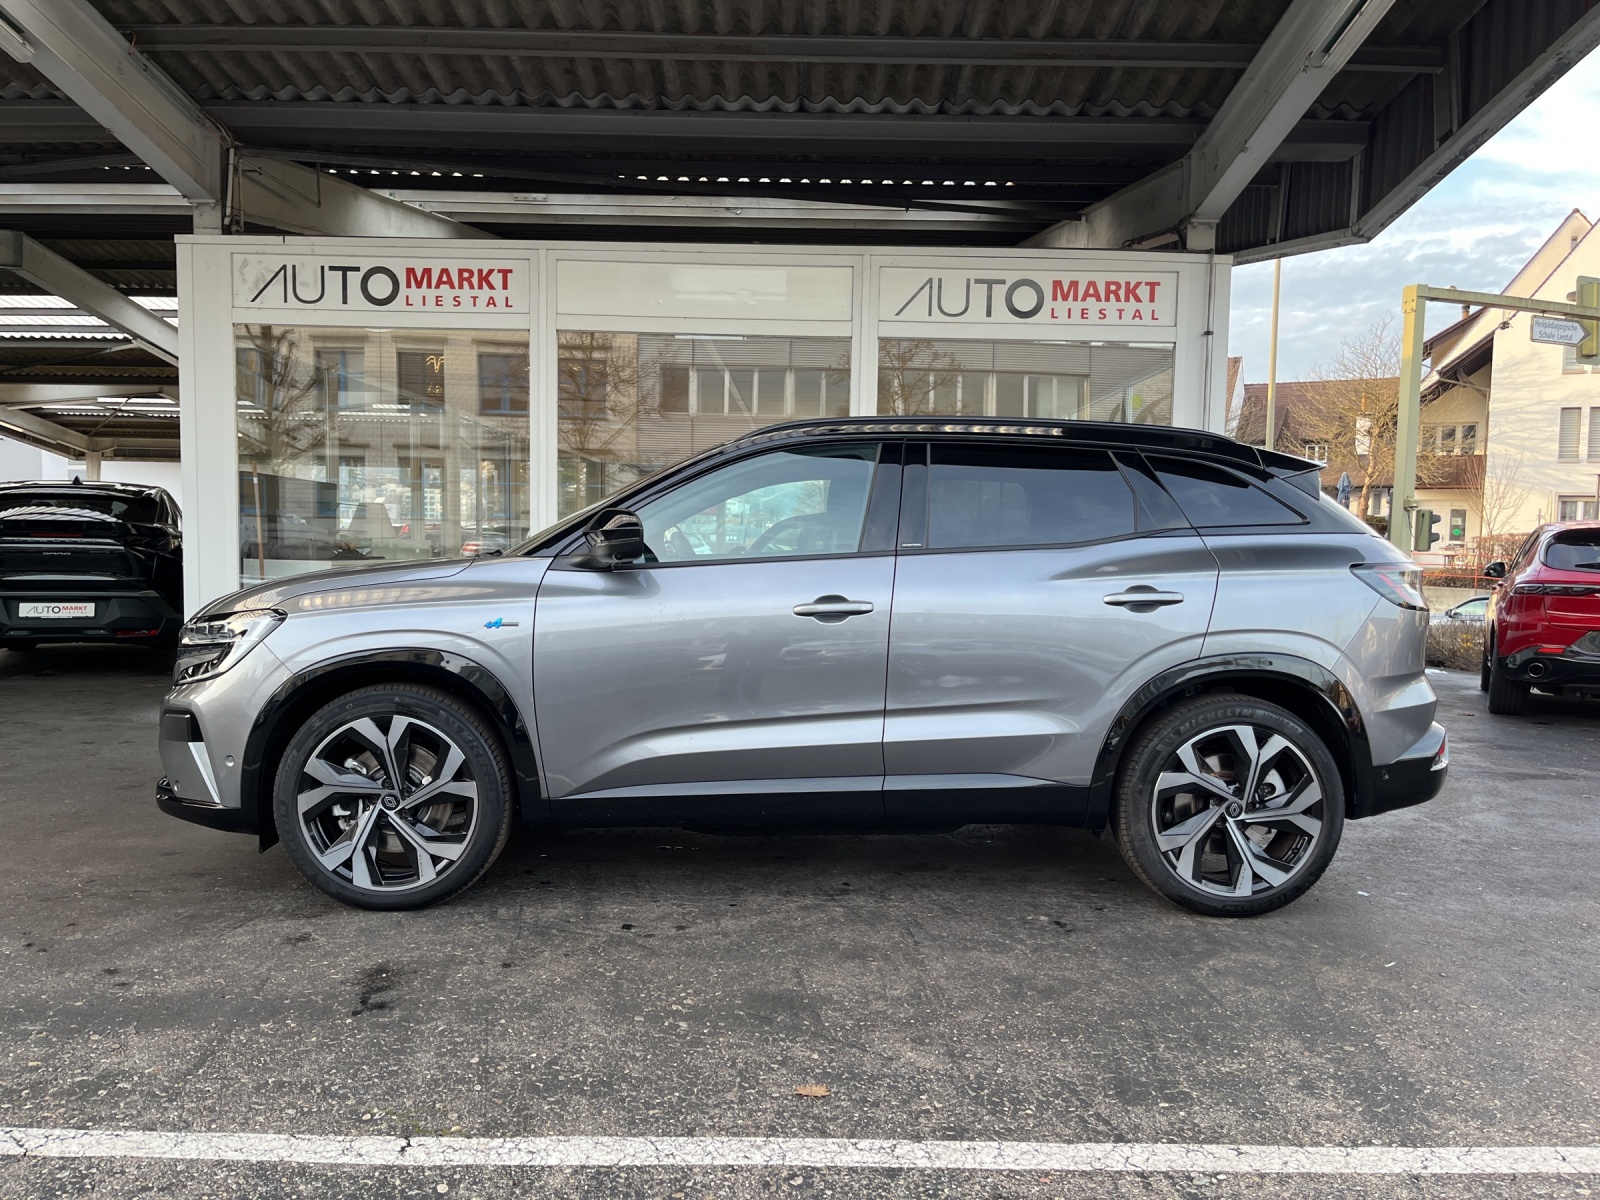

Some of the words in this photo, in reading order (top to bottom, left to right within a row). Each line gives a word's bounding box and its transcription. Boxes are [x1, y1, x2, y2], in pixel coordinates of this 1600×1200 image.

[250, 264, 400, 307] AUTO
[405, 267, 514, 291] MARKT
[405, 295, 514, 308] LIESTAL
[894, 277, 1045, 319] AUTO
[1051, 279, 1161, 303] MARKT
[1050, 307, 1160, 321] LIESTAL
[1534, 320, 1578, 332] Heilpädagogische
[1538, 330, 1556, 340] Schule
[1556, 332, 1573, 342] Liestal
[26, 605, 61, 614] AUTO
[1179, 708, 1253, 735] MICHELIN
